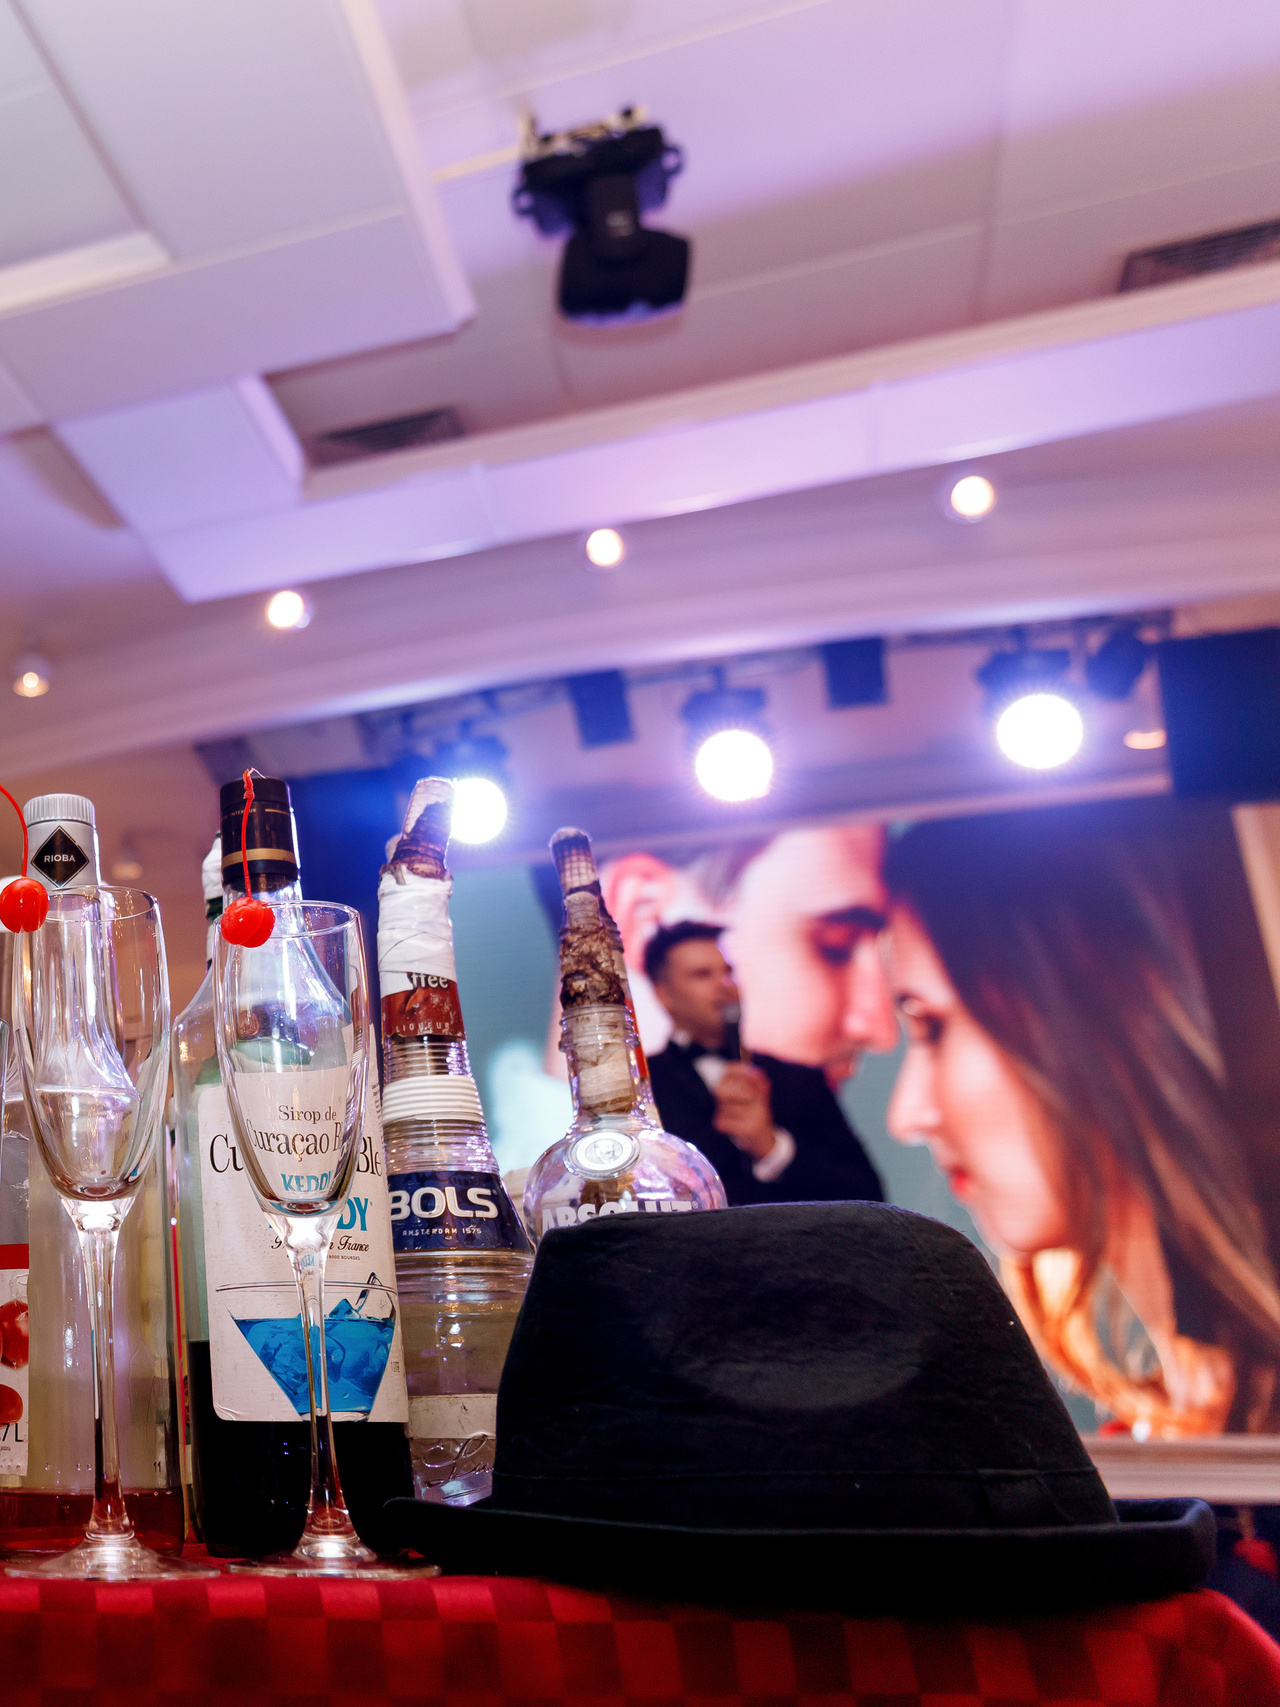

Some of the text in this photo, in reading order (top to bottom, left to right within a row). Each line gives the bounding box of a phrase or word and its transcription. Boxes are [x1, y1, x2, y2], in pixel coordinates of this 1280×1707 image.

[44, 853, 76, 864] RIOBA
[411, 972, 449, 988] ffee
[395, 1021, 450, 1033] LIQUEUR
[278, 1104, 337, 1125] Sirop de
[246, 1118, 330, 1162] Curaçao
[388, 1186, 498, 1221] BOLS
[402, 1227, 482, 1236] AMSTERDAM 1575
[338, 1235, 369, 1252] France
[15, 1423, 24, 1442] L
